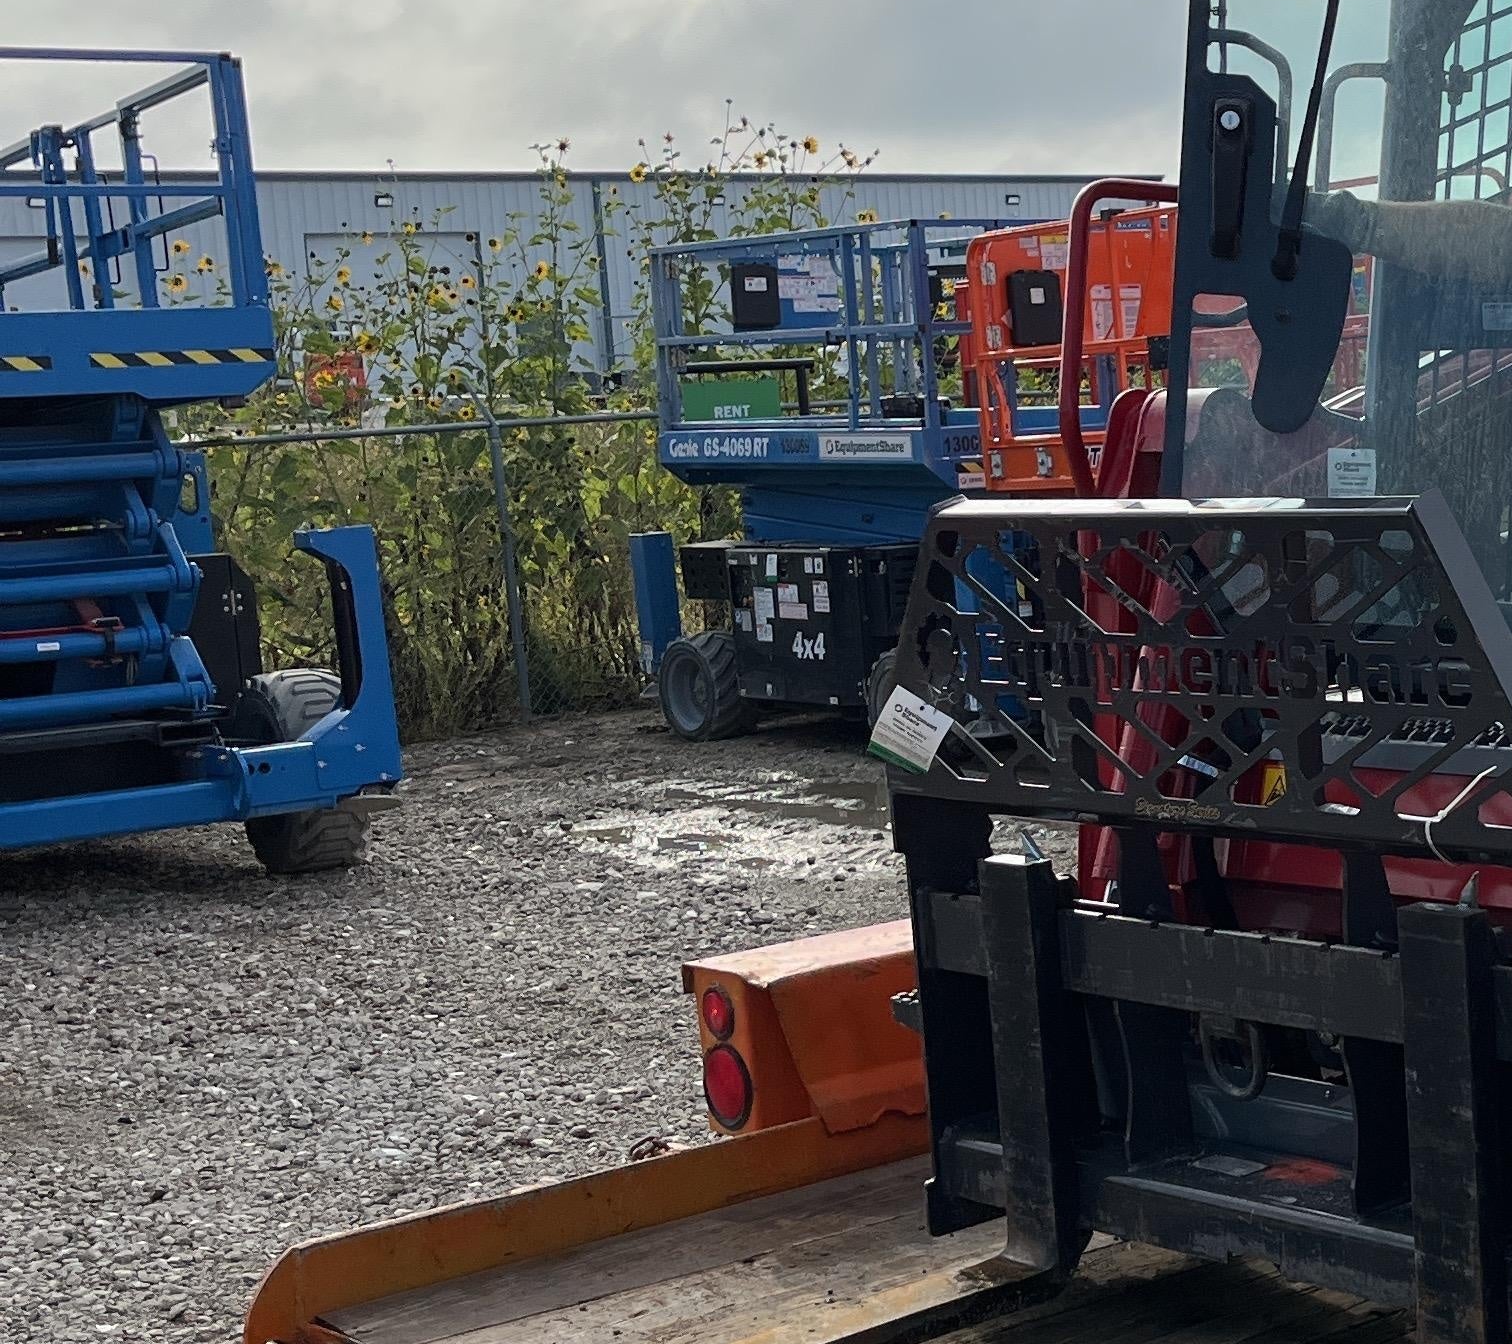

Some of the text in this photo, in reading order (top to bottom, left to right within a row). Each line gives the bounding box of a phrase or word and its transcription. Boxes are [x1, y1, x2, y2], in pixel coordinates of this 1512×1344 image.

[714, 405, 750, 419] RENT
[669, 438, 699, 458] Genie
[834, 440, 905, 456] EquipmentShare
[792, 631, 826, 660] 4x4
